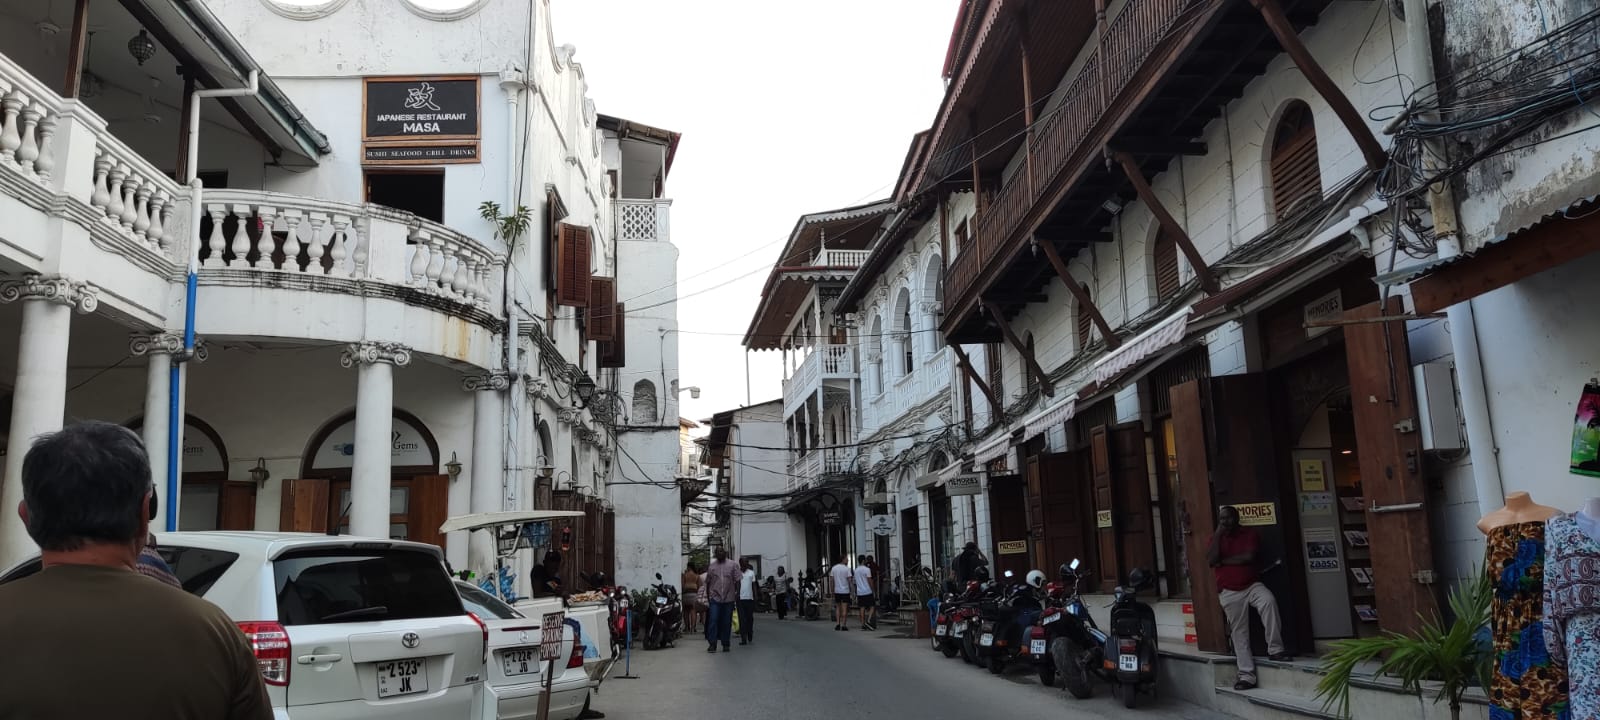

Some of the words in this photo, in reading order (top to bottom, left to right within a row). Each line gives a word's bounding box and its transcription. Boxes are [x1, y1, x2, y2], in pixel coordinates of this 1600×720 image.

[377, 114, 415, 122] JAPANESE
[416, 113, 467, 121] RESTAURANT
[403, 122, 441, 133] MASA
[392, 442, 418, 450] Gems
[1236, 505, 1272, 518] MORIES
[389, 662, 396, 678] Z
[398, 660, 418, 677] 523
[400, 676, 412, 692] JK
